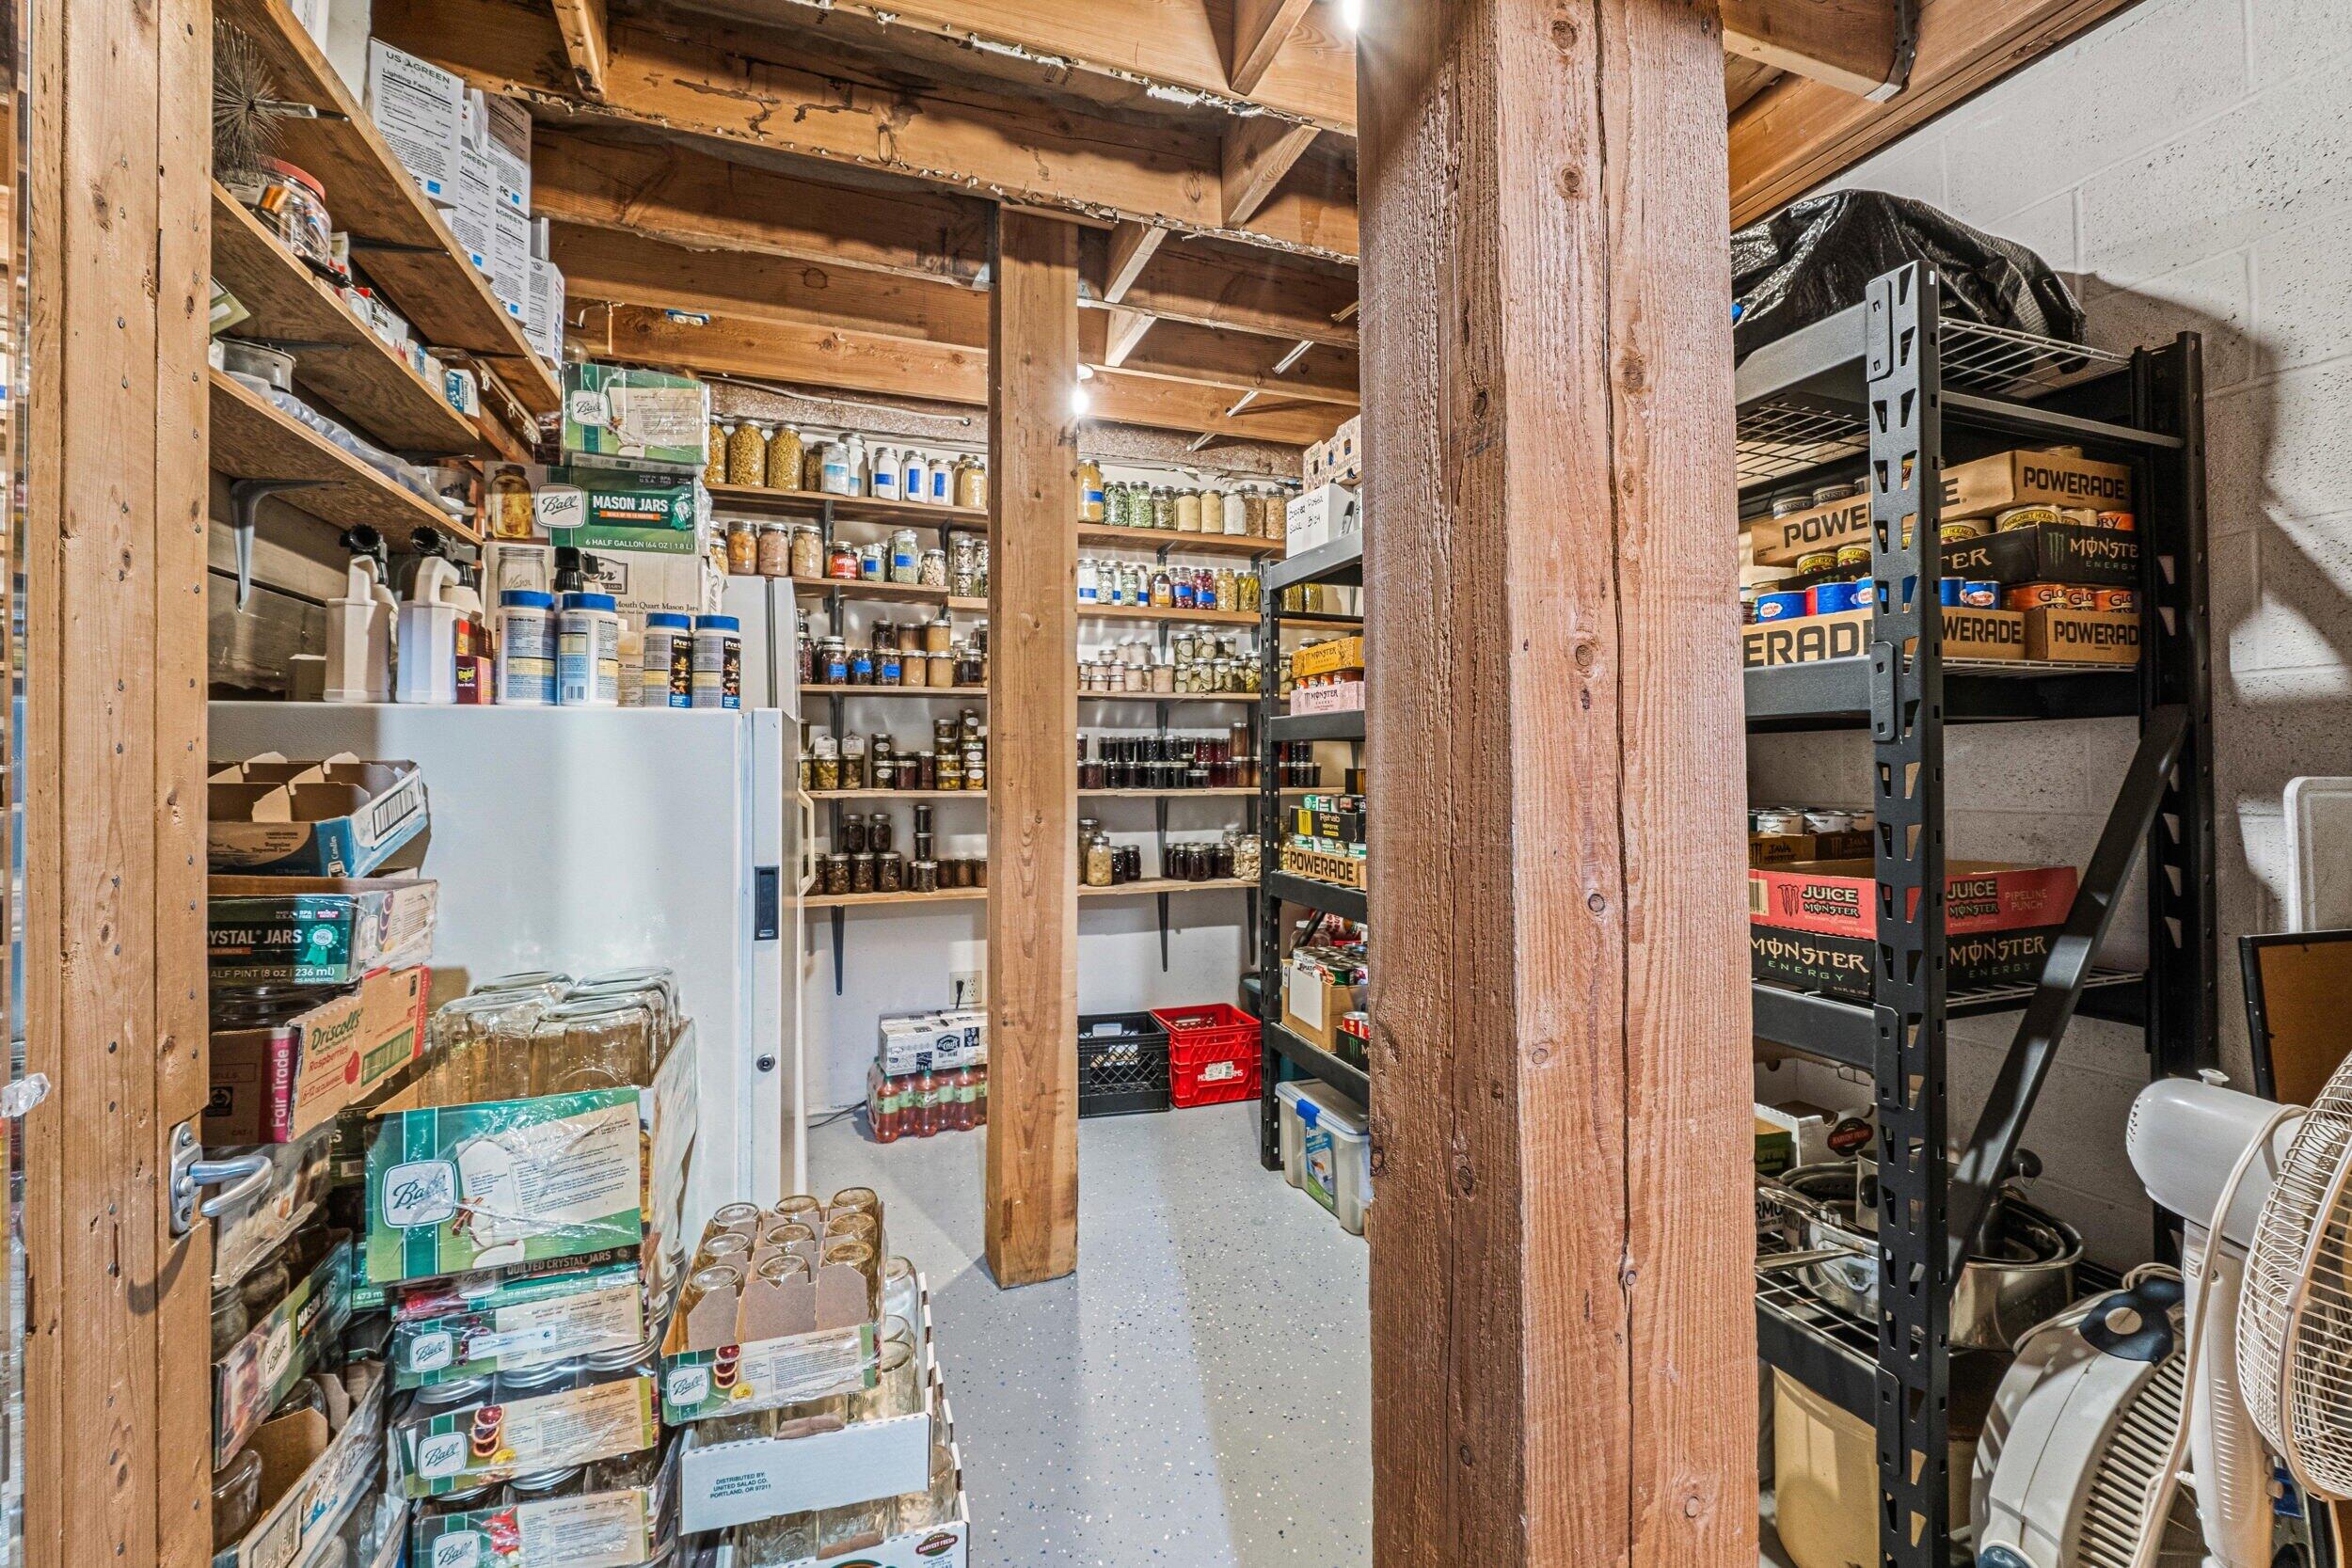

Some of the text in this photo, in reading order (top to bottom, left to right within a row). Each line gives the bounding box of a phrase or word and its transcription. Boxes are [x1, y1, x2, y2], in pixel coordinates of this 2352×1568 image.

[382, 68, 411, 85] Lighting
[386, 51, 450, 84] US GREEN
[461, 150, 487, 168] GREEN
[2024, 466, 2125, 500] POWERADE
[542, 495, 580, 515] Ball
[593, 495, 669, 513] MASON JARS
[2070, 536, 2139, 559] MONSTE
[2086, 560, 2137, 571] ENERGY
[2039, 589, 2065, 602] GLO
[639, 601, 660, 610] Quart
[686, 603, 699, 611] Jars
[1942, 615, 2022, 644] WERADE
[2054, 620, 2138, 646] POWERAD
[1311, 647, 1337, 659] MONSTER
[1743, 622, 1872, 668] ERAD
[1311, 689, 1338, 700] MONSTER
[1319, 813, 1341, 823] Rehab
[330, 835, 340, 860] Candles
[1290, 850, 1355, 882] POWERADE
[1803, 885, 1858, 903] JUICE
[1947, 880, 1996, 899] JUICE
[2005, 889, 2048, 900] PIPELINE
[1804, 902, 1860, 917] MONSTER
[1949, 901, 1998, 919] MONSTER
[2011, 901, 2042, 911] PUNCH
[263, 928, 303, 944] JARS
[1750, 937, 1869, 974] MONSTER
[1950, 936, 2047, 967] MONSTER
[211, 969, 231, 978] ALF
[233, 969, 259, 978] PINT
[261, 969, 271, 978] (8
[294, 968, 314, 976] 236
[316, 967, 335, 976] ml)
[1769, 960, 1844, 981] ENERGY
[1969, 962, 2032, 978] ENERGY
[308, 1045, 348, 1072] Raspberries
[274, 1049, 289, 1128] Fair Trade
[507, 1251, 612, 1275] QUILTED CRYSTAL JARS
[356, 1292, 372, 1301] 473
[415, 1339, 448, 1362] Ball
[673, 1373, 704, 1396] Ball
[424, 1441, 460, 1467] Ball
[713, 1482, 735, 1492] UNITED
[735, 1480, 756, 1488] SALAD
[715, 1474, 755, 1485] DISTRIBUTED
[710, 1488, 744, 1498] PORTLAND,
[437, 1540, 473, 1565] Ball
[918, 1537, 955, 1553] HARVEST FRESH
